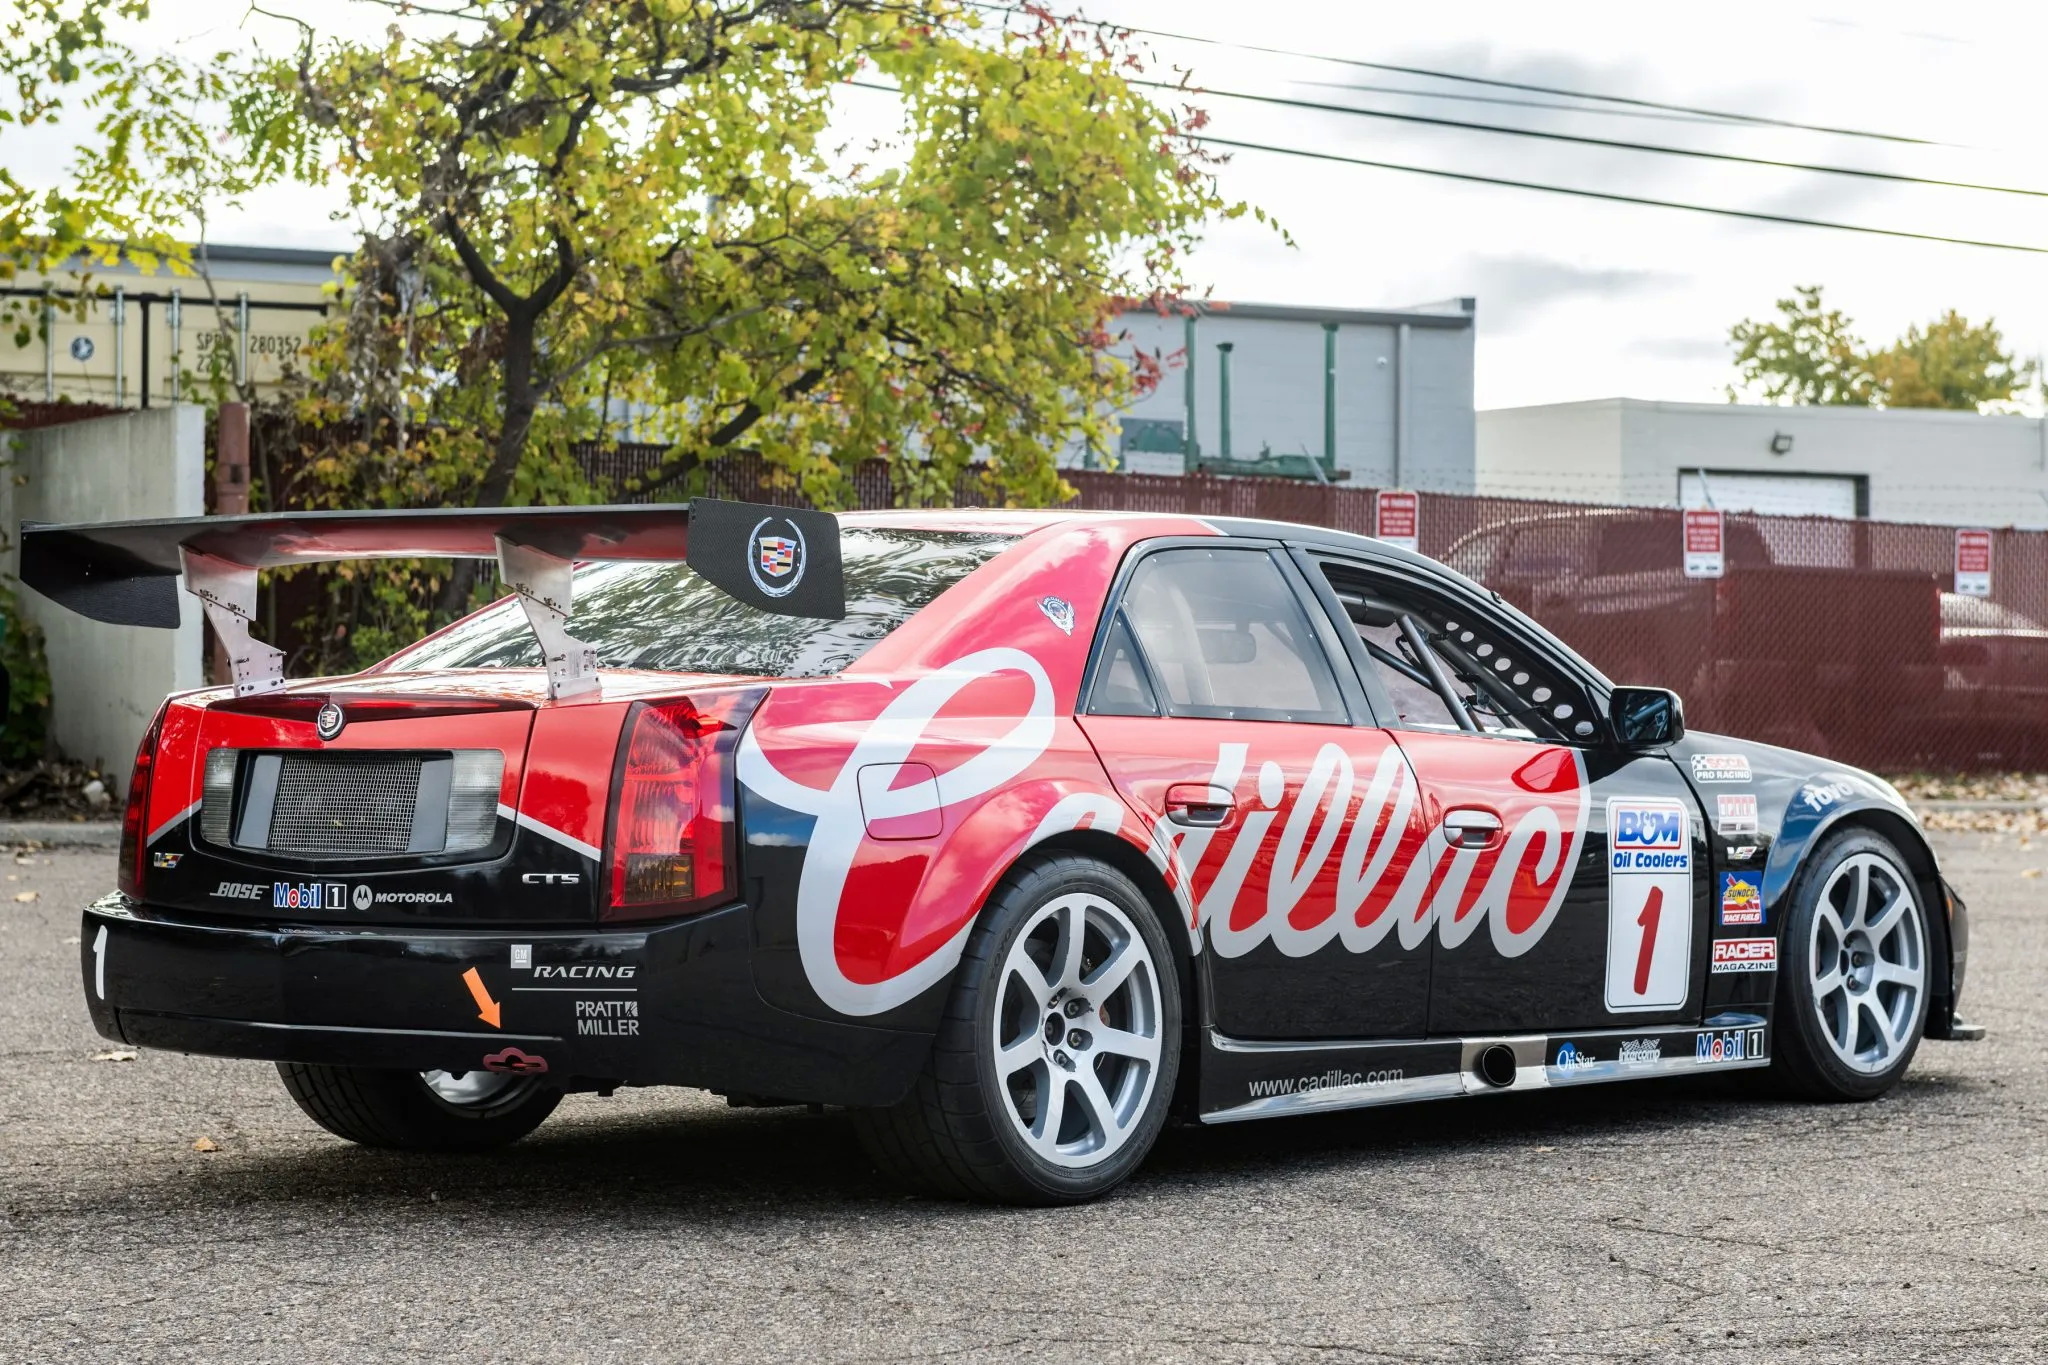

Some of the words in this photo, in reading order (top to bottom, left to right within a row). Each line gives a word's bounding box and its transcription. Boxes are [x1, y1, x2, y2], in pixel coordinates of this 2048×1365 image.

[1696, 771, 1714, 779] PRO
[1716, 771, 1750, 779] RACING
[1803, 782, 1853, 812] TOYO
[1617, 810, 1679, 845] B&M
[1613, 852, 1631, 868] Oil
[1635, 852, 1688, 868] Coolers
[522, 873, 580, 885] CTS
[210, 881, 269, 900] BOSE
[274, 882, 321, 909] Mobil
[375, 892, 453, 904] MOTOROLA
[1727, 888, 1756, 898] SUNOCO
[1724, 914, 1740, 922] RACE
[1740, 913, 1760, 922] FUELS
[1633, 885, 1663, 995] 1
[515, 949, 527, 960] GM
[1715, 942, 1774, 960] RACER
[93, 925, 108, 1000] 1
[1713, 962, 1775, 972] MAGAZINE
[534, 966, 636, 978] RACING
[576, 1001, 623, 1017] PRATT
[578, 1020, 639, 1036] MILLER
[1696, 1029, 1745, 1063] Mobil
[1556, 1050, 1595, 1071] OnStar
[1249, 1069, 1403, 1096] www.cadillac.com
